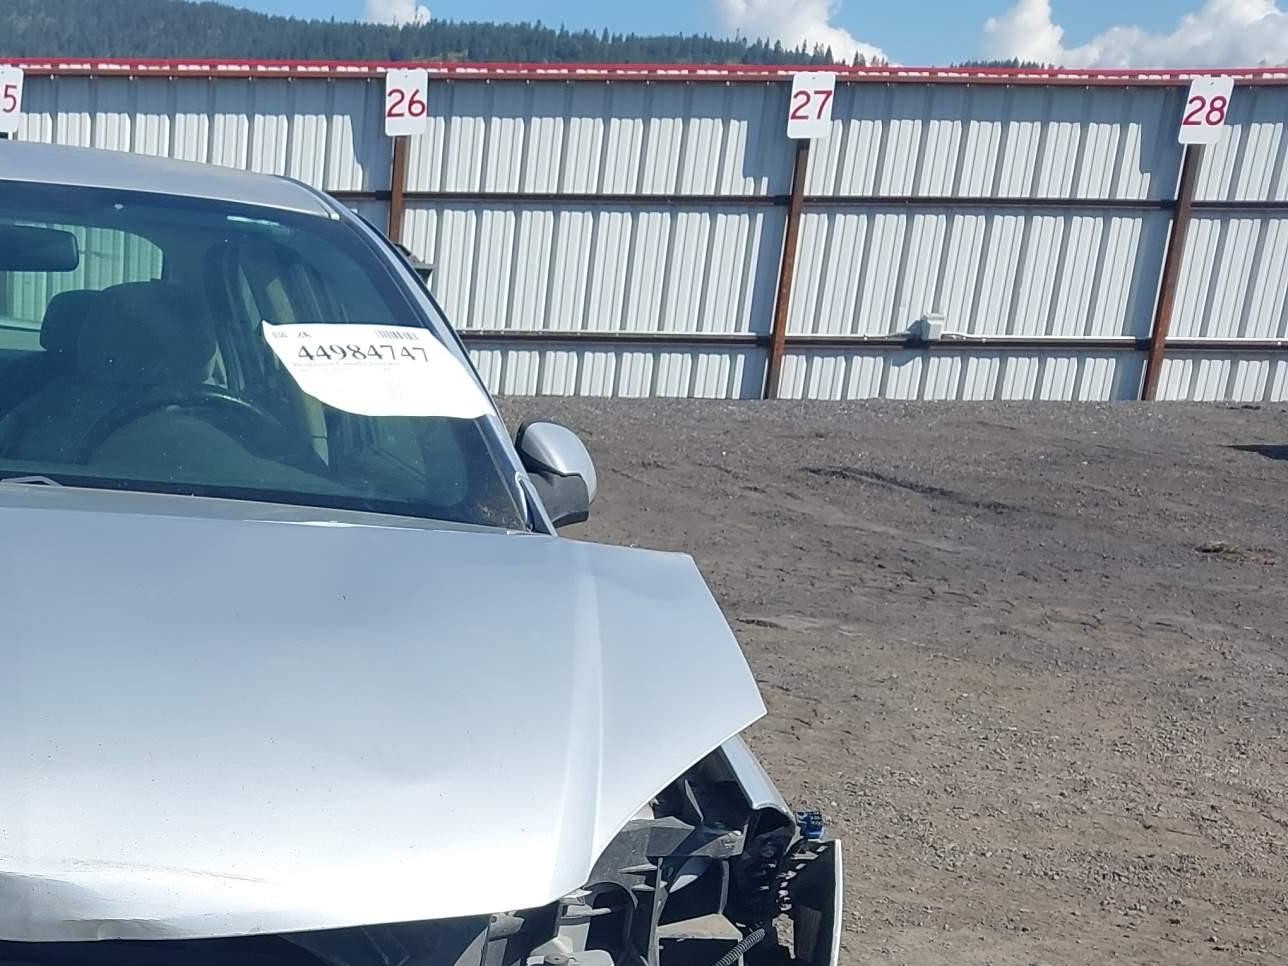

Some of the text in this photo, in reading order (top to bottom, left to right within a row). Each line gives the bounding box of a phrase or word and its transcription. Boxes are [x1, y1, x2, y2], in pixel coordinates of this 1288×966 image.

[387, 89, 425, 117] 26
[791, 90, 832, 119] 27
[1183, 96, 1227, 125] 28
[298, 344, 428, 362] 44984747
